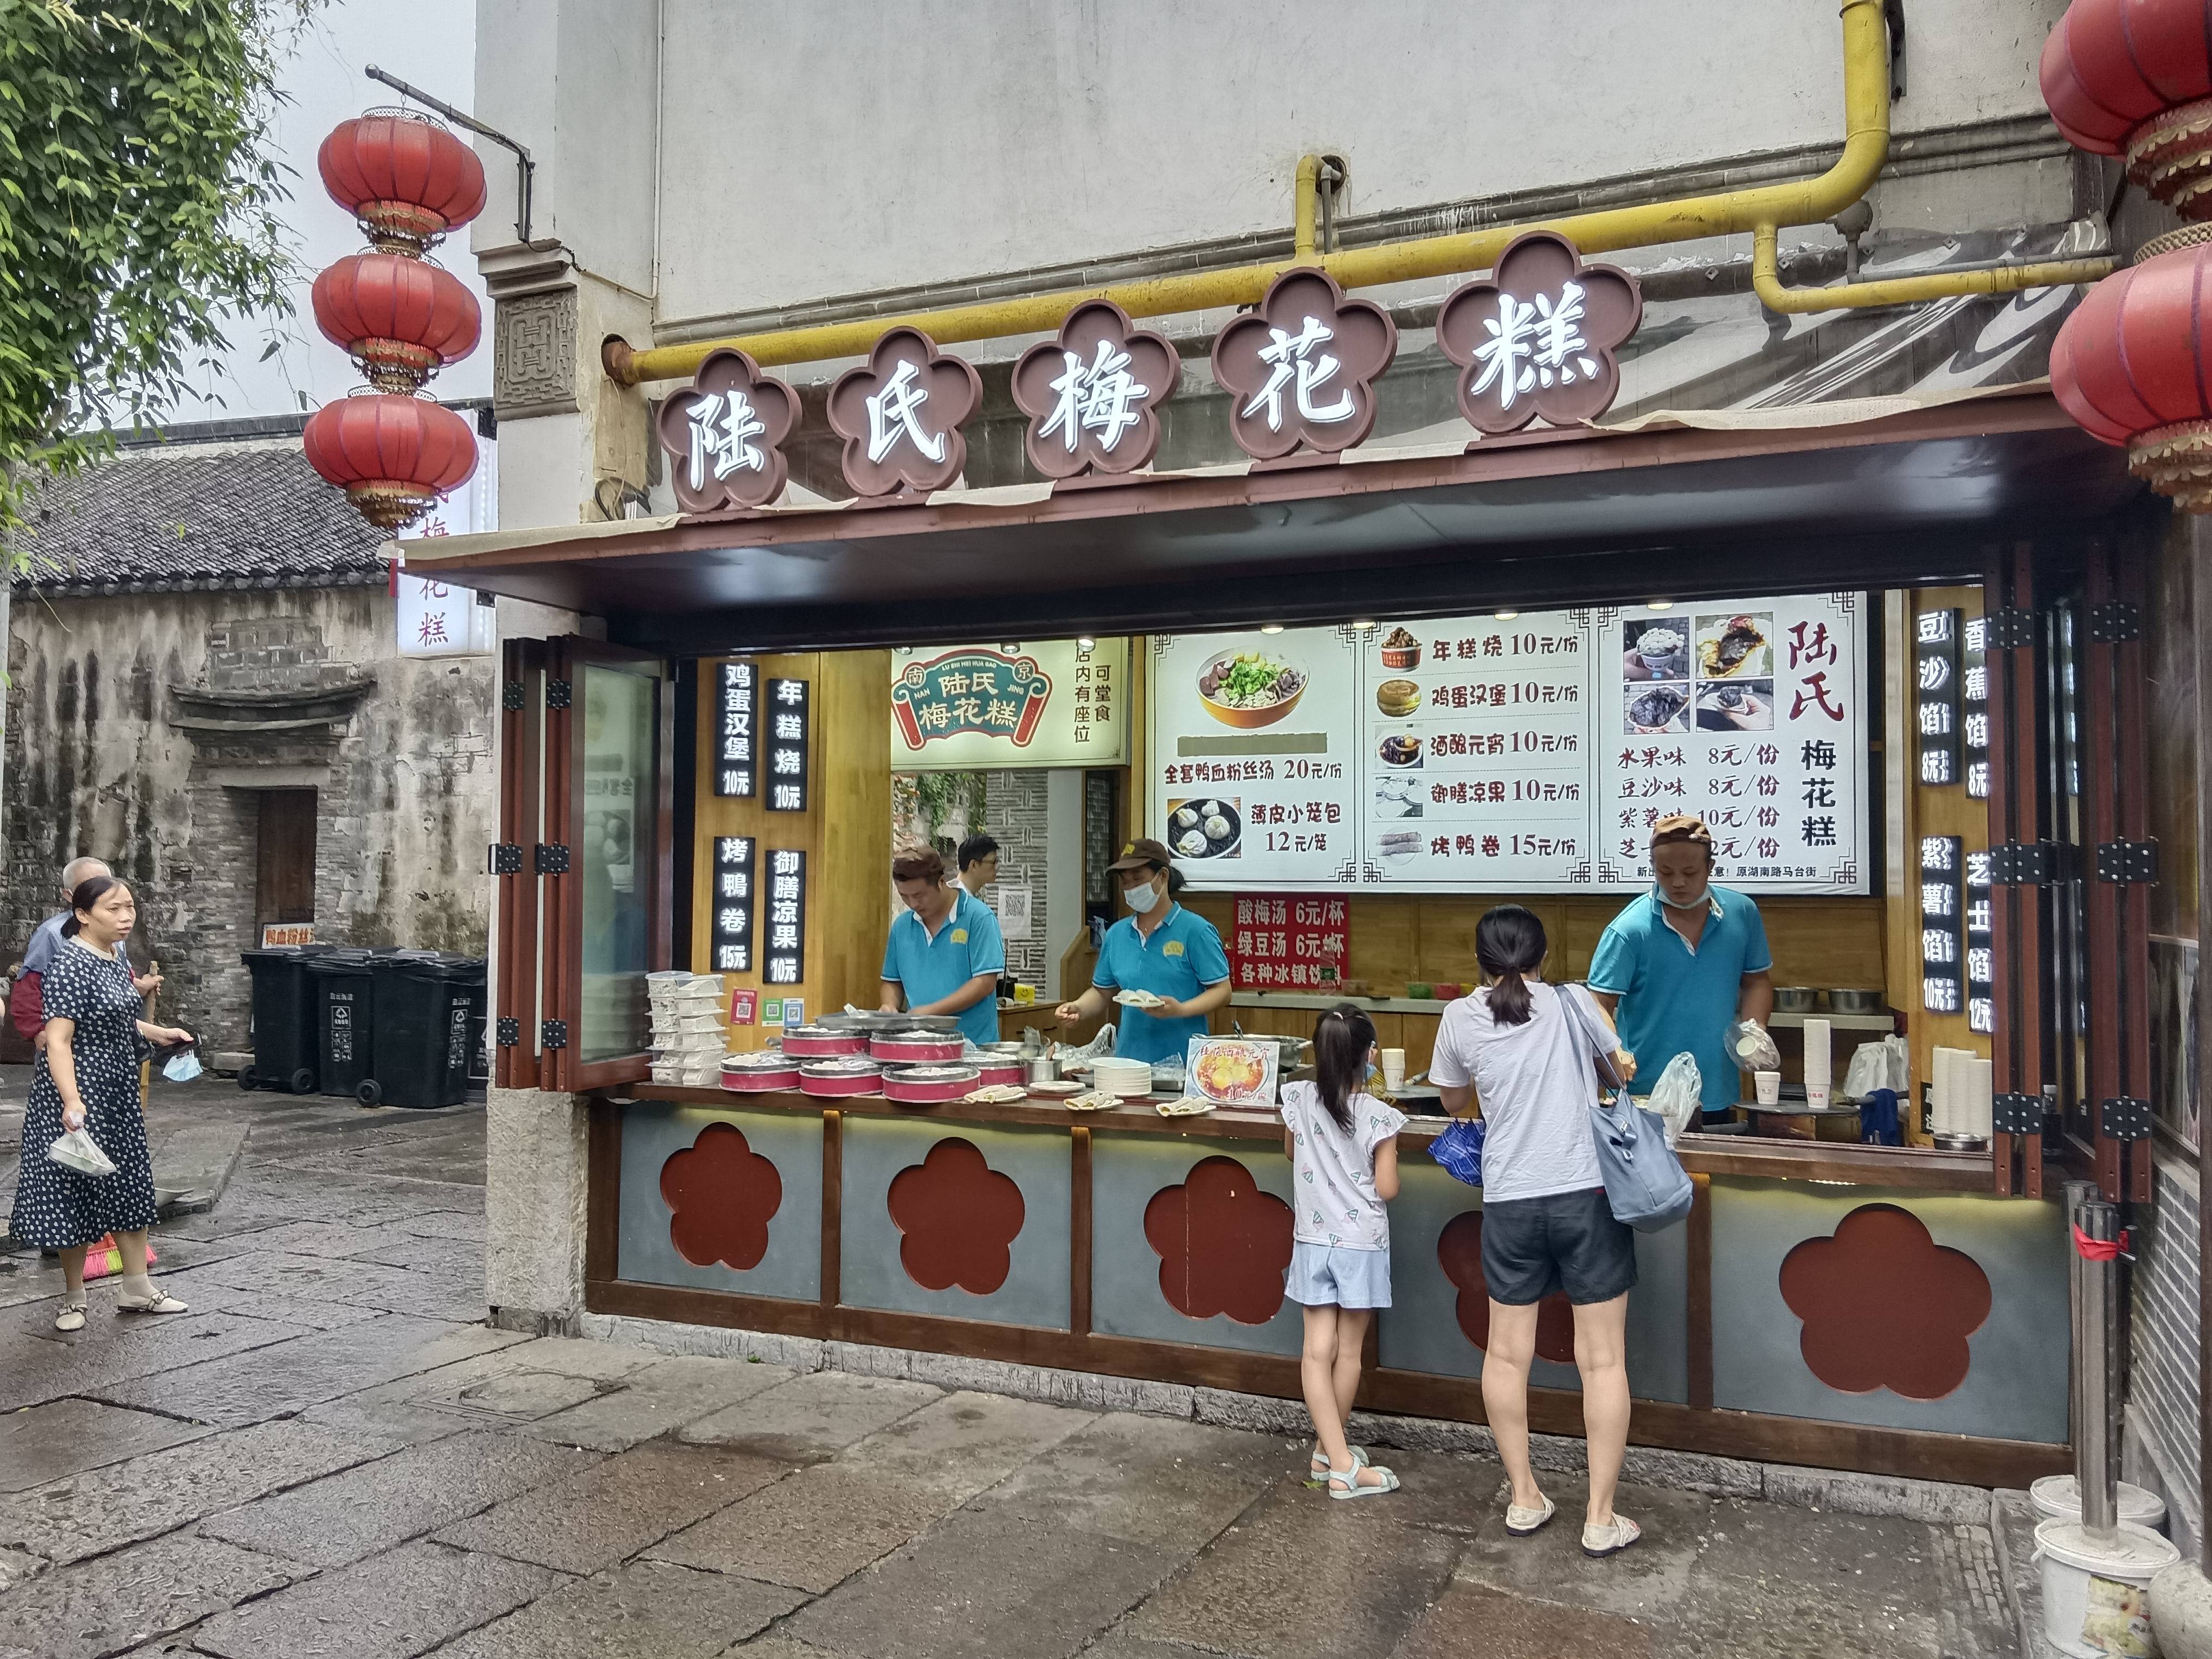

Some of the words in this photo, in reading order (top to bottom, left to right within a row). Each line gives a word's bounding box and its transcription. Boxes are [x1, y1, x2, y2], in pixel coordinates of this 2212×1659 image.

[685, 279, 1600, 492] 陆氏梅花糕
[1432, 635, 1502, 661] 年糕烧
[1787, 621, 1844, 722] 陆氏
[914, 688, 930, 699] NAN
[1007, 684, 1024, 696] JING
[938, 672, 998, 697] 陆氏
[1095, 665, 1111, 722] 可堂食
[919, 697, 1018, 730] 梅花糕
[1431, 733, 1504, 756] 酒酿元宵
[1617, 745, 1687, 769] 水果味
[1164, 760, 1274, 785] 全套鸭血粉丝汤
[1431, 781, 1505, 803] 御膳凉果
[1617, 777, 1687, 799] 豆沙味
[1801, 740, 1837, 847] 梅花糕
[1251, 802, 1341, 825] 薄皮小笼包
[1431, 835, 1500, 857] 烤鸭卷
[1711, 836, 1780, 858] 2元/份
[1238, 899, 1286, 925] 酸梅汤
[1296, 899, 1344, 926] 6元/杯
[1238, 930, 1286, 957] 绿豆汤
[1296, 932, 1344, 958] 6元杯
